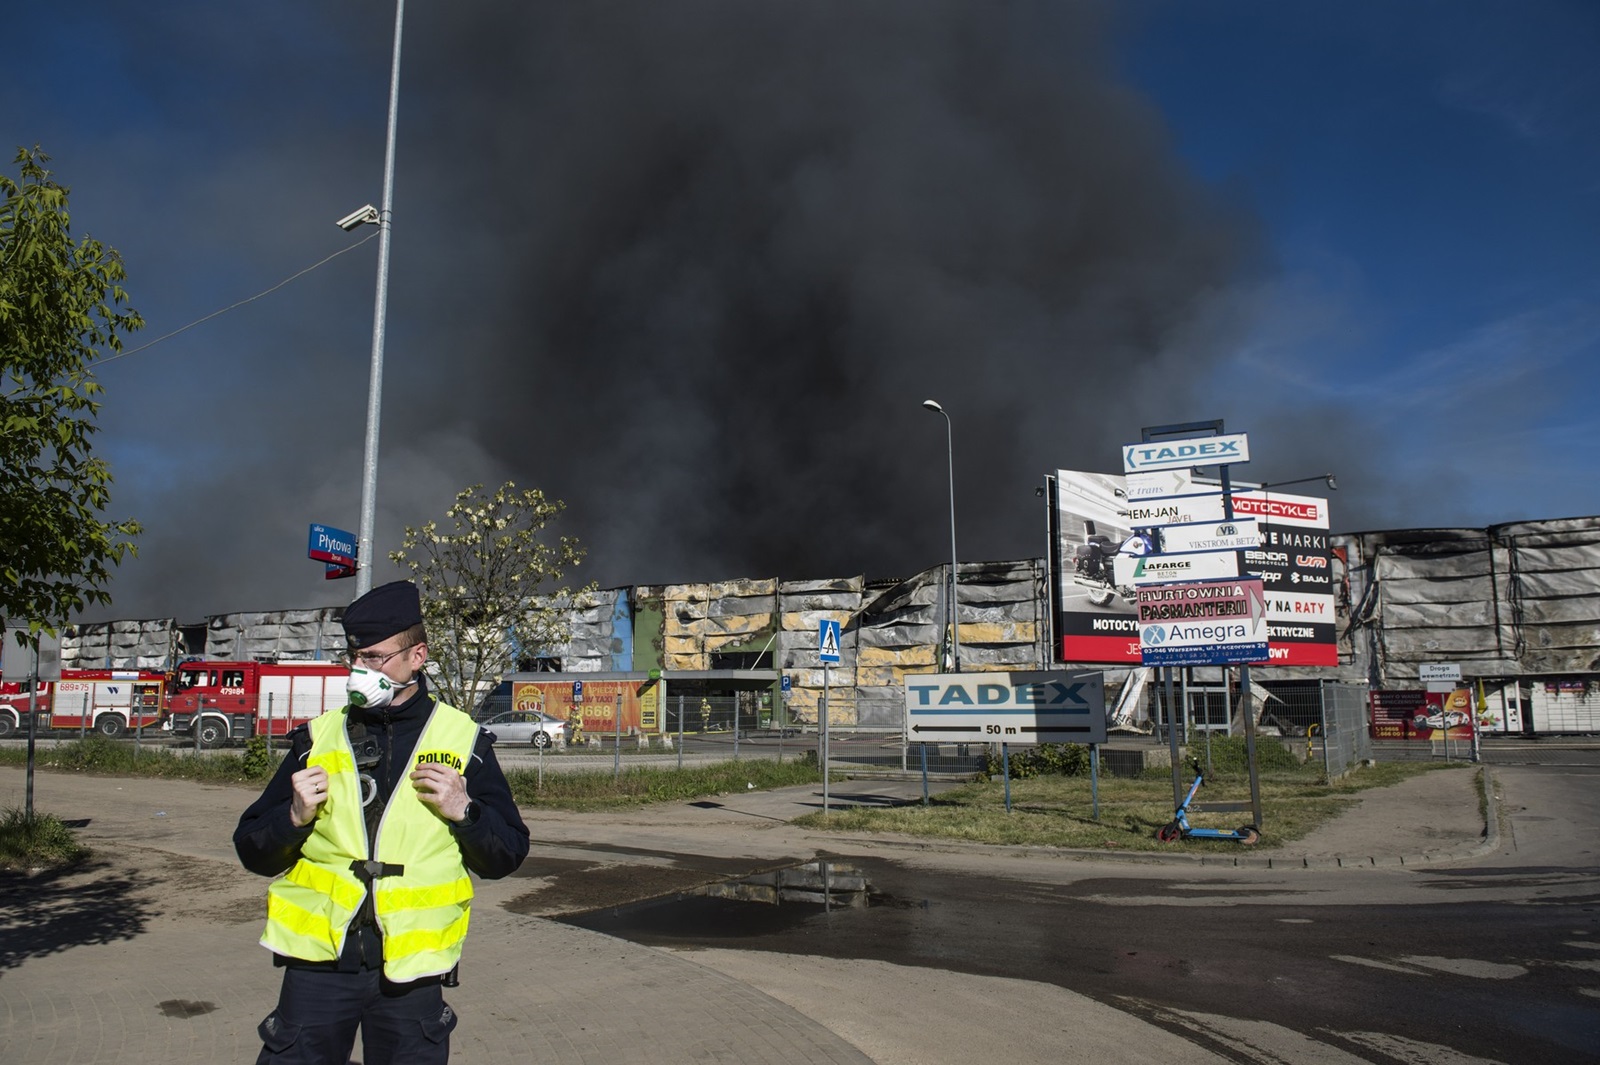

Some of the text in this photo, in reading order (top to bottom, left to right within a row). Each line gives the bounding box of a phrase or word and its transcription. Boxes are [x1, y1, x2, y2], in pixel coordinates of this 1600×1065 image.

[1138, 440, 1238, 460] TADEX
[1137, 486, 1164, 495] trans
[1231, 500, 1317, 517] MOTOCYKLE
[1167, 514, 1193, 524] JAVEL
[1220, 526, 1235, 536] VB
[318, 534, 352, 554] Płytowa
[1189, 538, 1229, 549] VIKSTROM
[1282, 533, 1326, 549] MARKI
[1244, 550, 1288, 561] BENDA
[1142, 561, 1191, 570] LAFARGE
[1302, 575, 1329, 583] BAJAJ
[1140, 585, 1245, 602] HURTOWNIA
[1140, 600, 1248, 620] PASMANTERII
[1276, 601, 1291, 612] NA
[1295, 602, 1325, 614] RATY
[1169, 624, 1246, 642] Amegra
[1268, 648, 1289, 658] OWY
[908, 682, 1089, 705] TADEX
[986, 725, 1000, 735] 50
[417, 753, 462, 770] POLICJA
